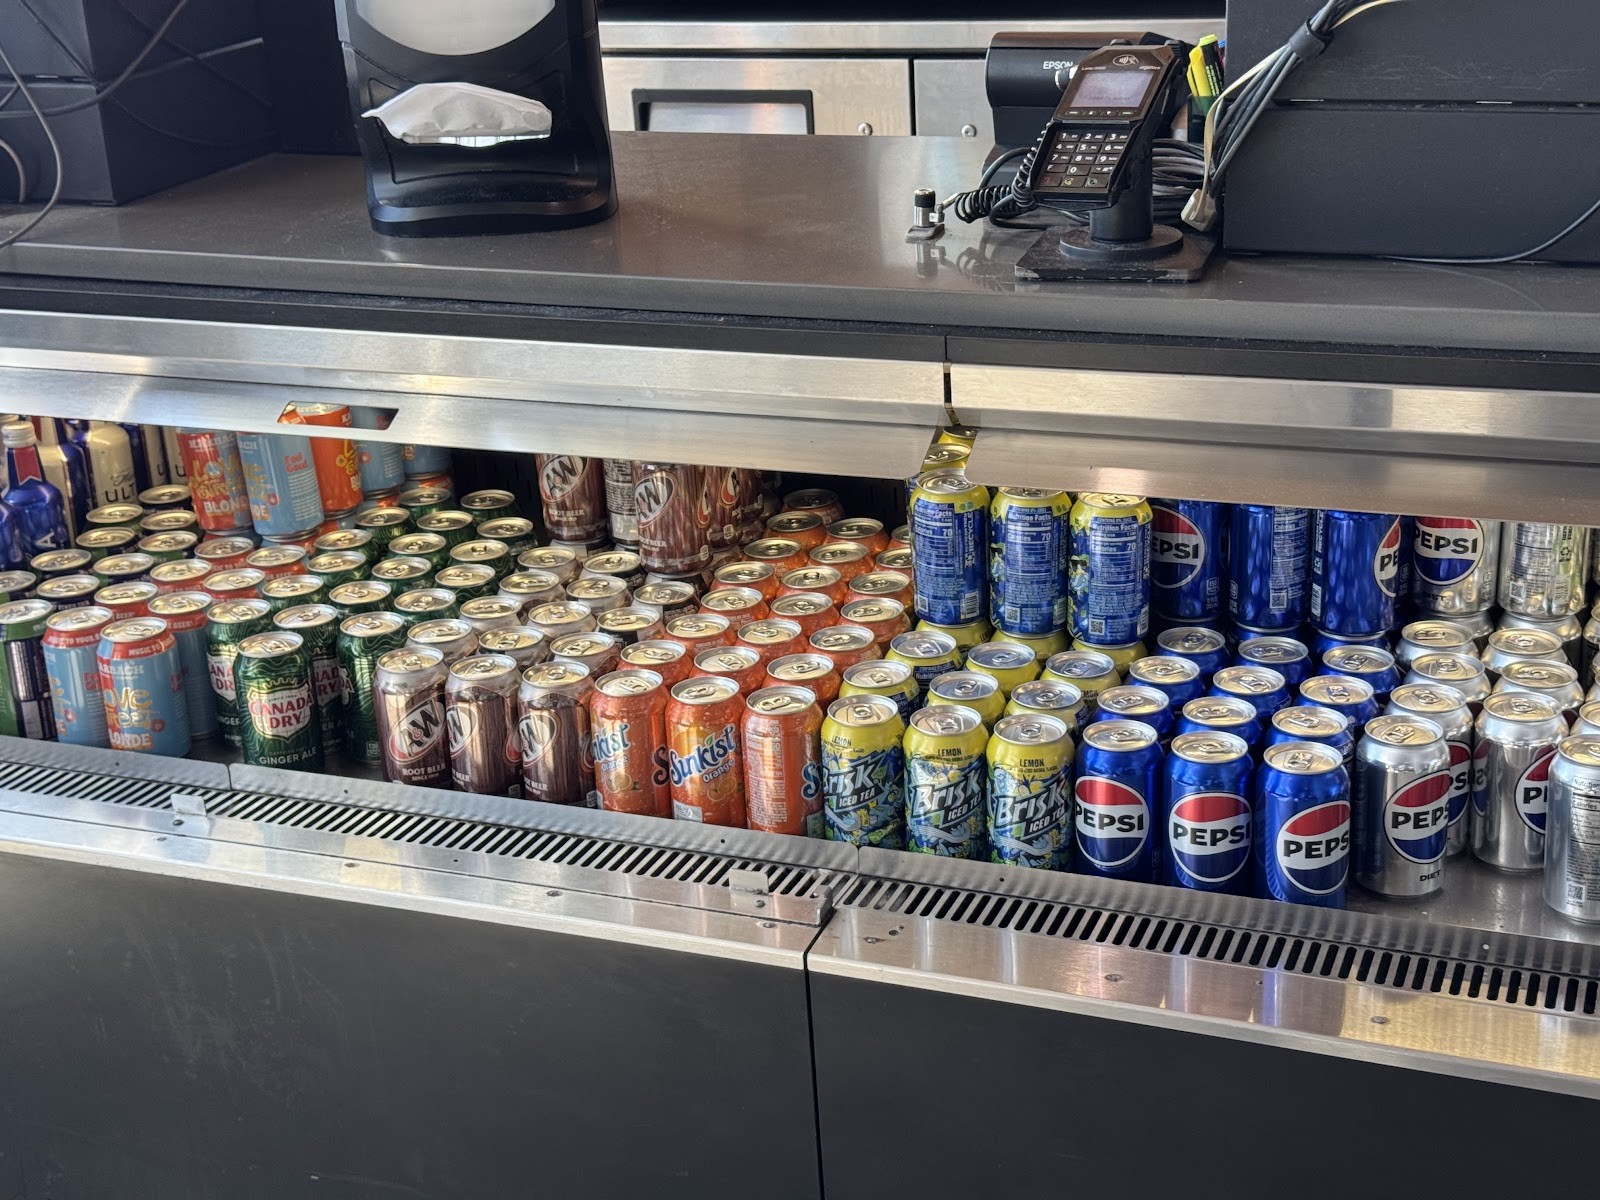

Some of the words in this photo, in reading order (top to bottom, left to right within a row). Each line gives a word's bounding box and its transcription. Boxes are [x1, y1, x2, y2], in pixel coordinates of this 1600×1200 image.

[1043, 61, 1073, 70] EPSON
[942, 528, 953, 537] 70
[1041, 532, 1051, 541] 70
[1127, 542, 1137, 551] 70
[248, 694, 314, 716] CANADA
[269, 711, 303, 729] DRY
[400, 699, 440, 758] A&W
[259, 753, 300, 765] GINGER
[301, 746, 317, 760] ALE
[668, 722, 736, 787] Sunkist
[937, 747, 963, 757] LEMON
[401, 766, 426, 776] ROOT
[702, 758, 735, 784] Orange
[1019, 758, 1045, 768] LEMON
[838, 795, 858, 808] ICED
[860, 787, 876, 802] TEA
[947, 803, 969, 821] ICED
[1075, 803, 1145, 832] PEPSI
[1029, 815, 1051, 833] ICED
[1283, 830, 1350, 860] PEPS
[1419, 869, 1441, 882] DIET
